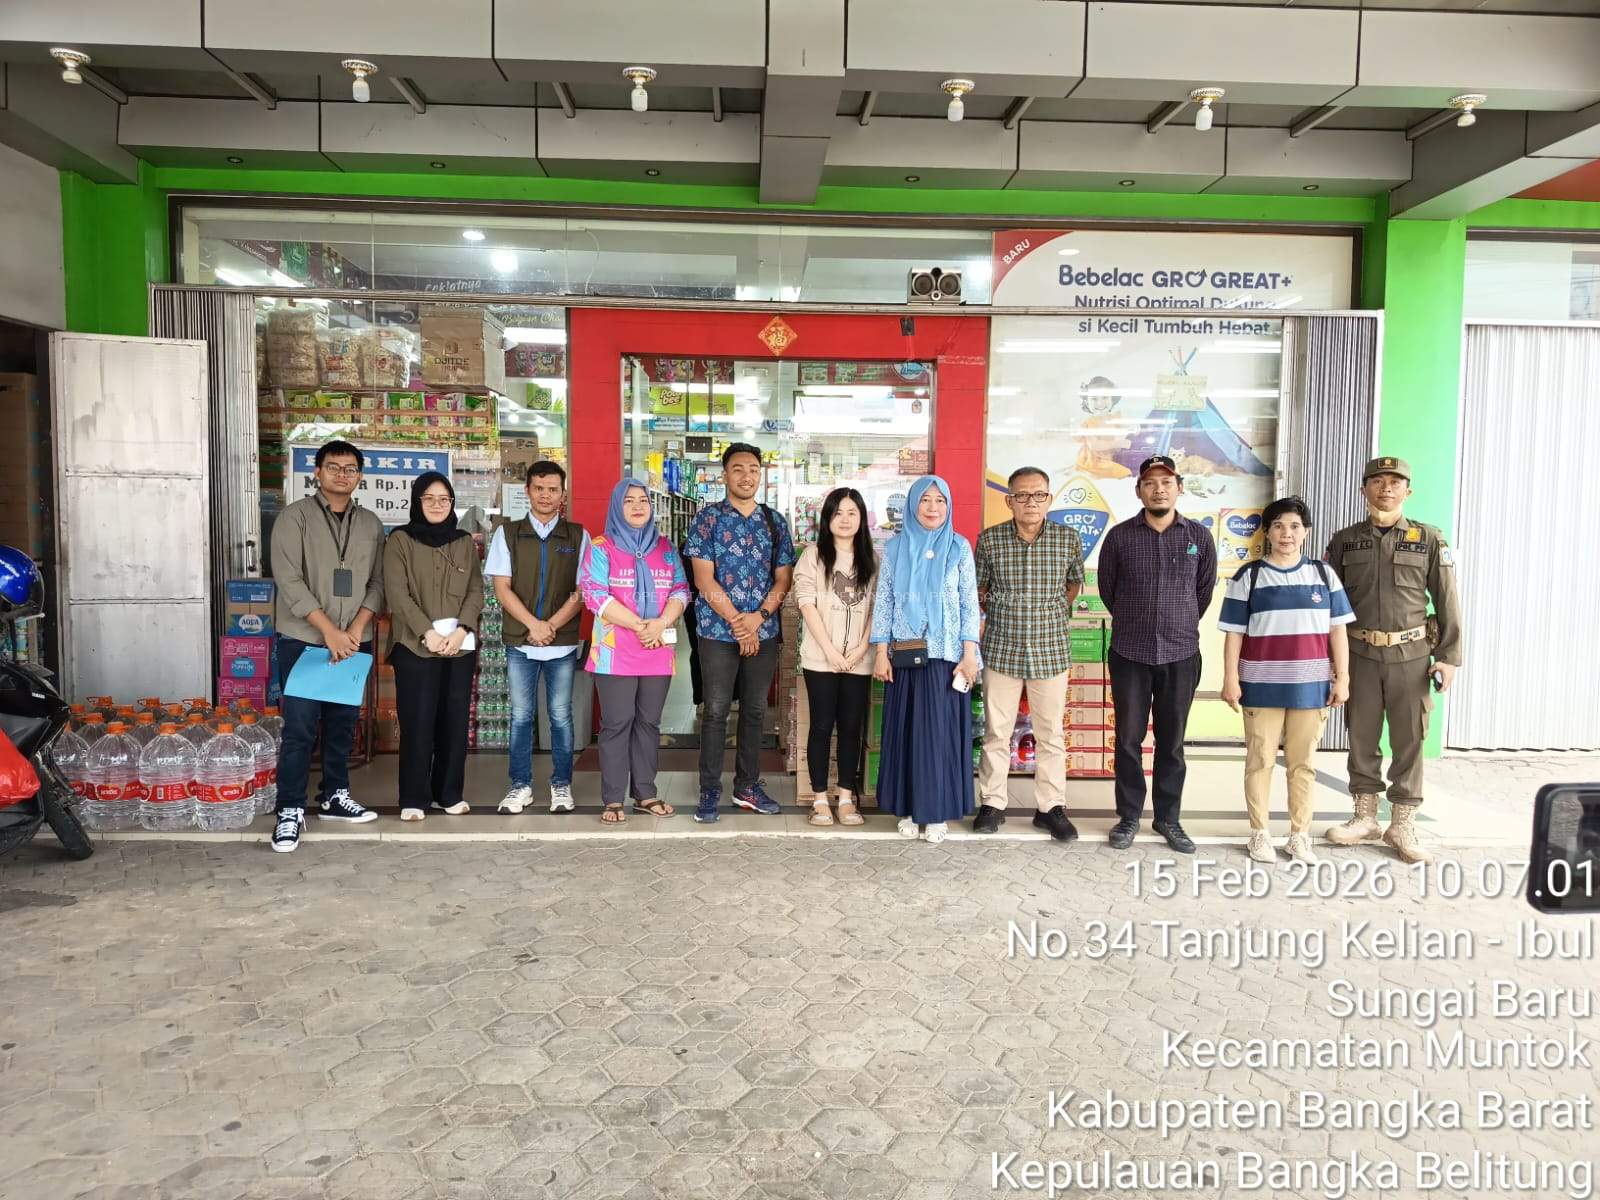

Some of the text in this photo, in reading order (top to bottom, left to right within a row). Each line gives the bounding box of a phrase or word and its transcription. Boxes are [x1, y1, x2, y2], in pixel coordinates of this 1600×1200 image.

[1002, 239, 1031, 265] BARU
[1058, 264, 1144, 288] Bebelac
[1075, 295, 1130, 308] Nutrisi
[1136, 296, 1204, 309] Optimal
[1078, 318, 1270, 335] si Kecil Tumbuh Hebat
[1230, 521, 1257, 530] Bebelac
